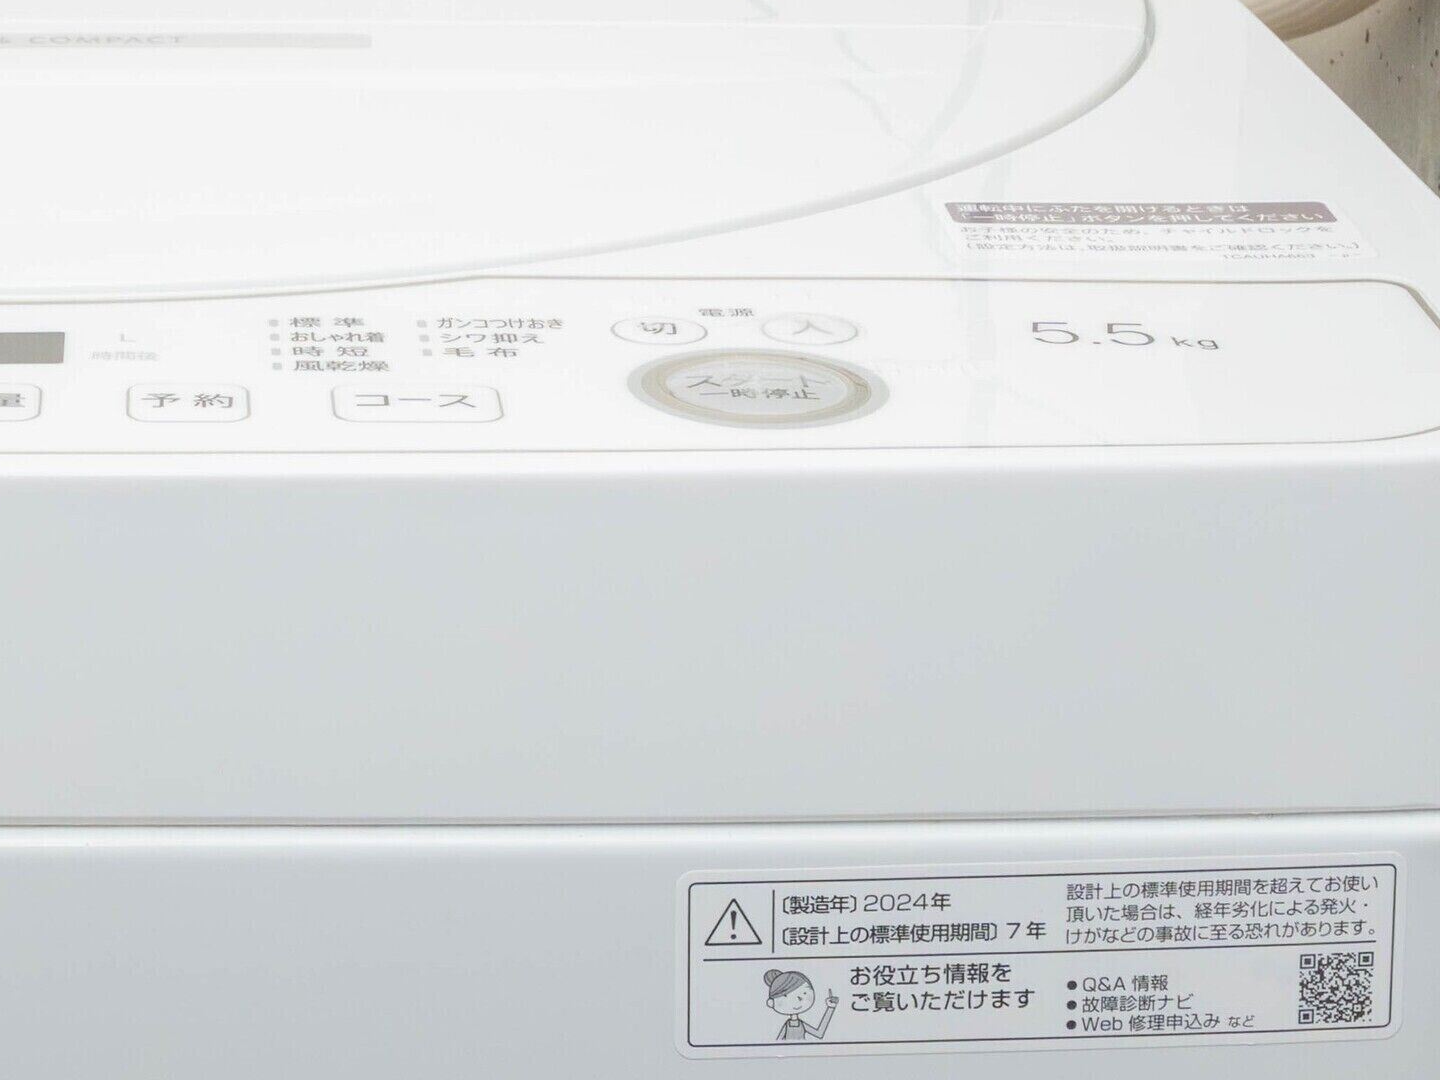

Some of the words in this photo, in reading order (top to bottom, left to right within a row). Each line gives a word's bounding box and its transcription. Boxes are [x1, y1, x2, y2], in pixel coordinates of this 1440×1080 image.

[28, 35, 186, 45] COMPACT
[436, 317, 566, 329] ガンコつけおき
[639, 321, 678, 335] 切
[290, 331, 386, 343] おしゃれ着
[440, 332, 545, 344] シワ抑え
[1031, 321, 1156, 346] 5.5
[1171, 335, 1220, 351] kg
[294, 360, 390, 372] 風乾燥
[686, 373, 834, 388] スタート
[140, 392, 235, 409] 予約
[355, 394, 477, 408] コース
[699, 387, 821, 401] 一時停止
[1066, 875, 1379, 901] 設計上の標準使用期間を超えてお使い
[1065, 919, 1377, 945] けがなどの事故に至る恐れがあります。
[850, 963, 1012, 986] お役立ち情報を
[850, 988, 1035, 1012] ご覧いただけます
[1081, 993, 1195, 1013] 故障診断ナビ
[1081, 1016, 1123, 1031] Web
